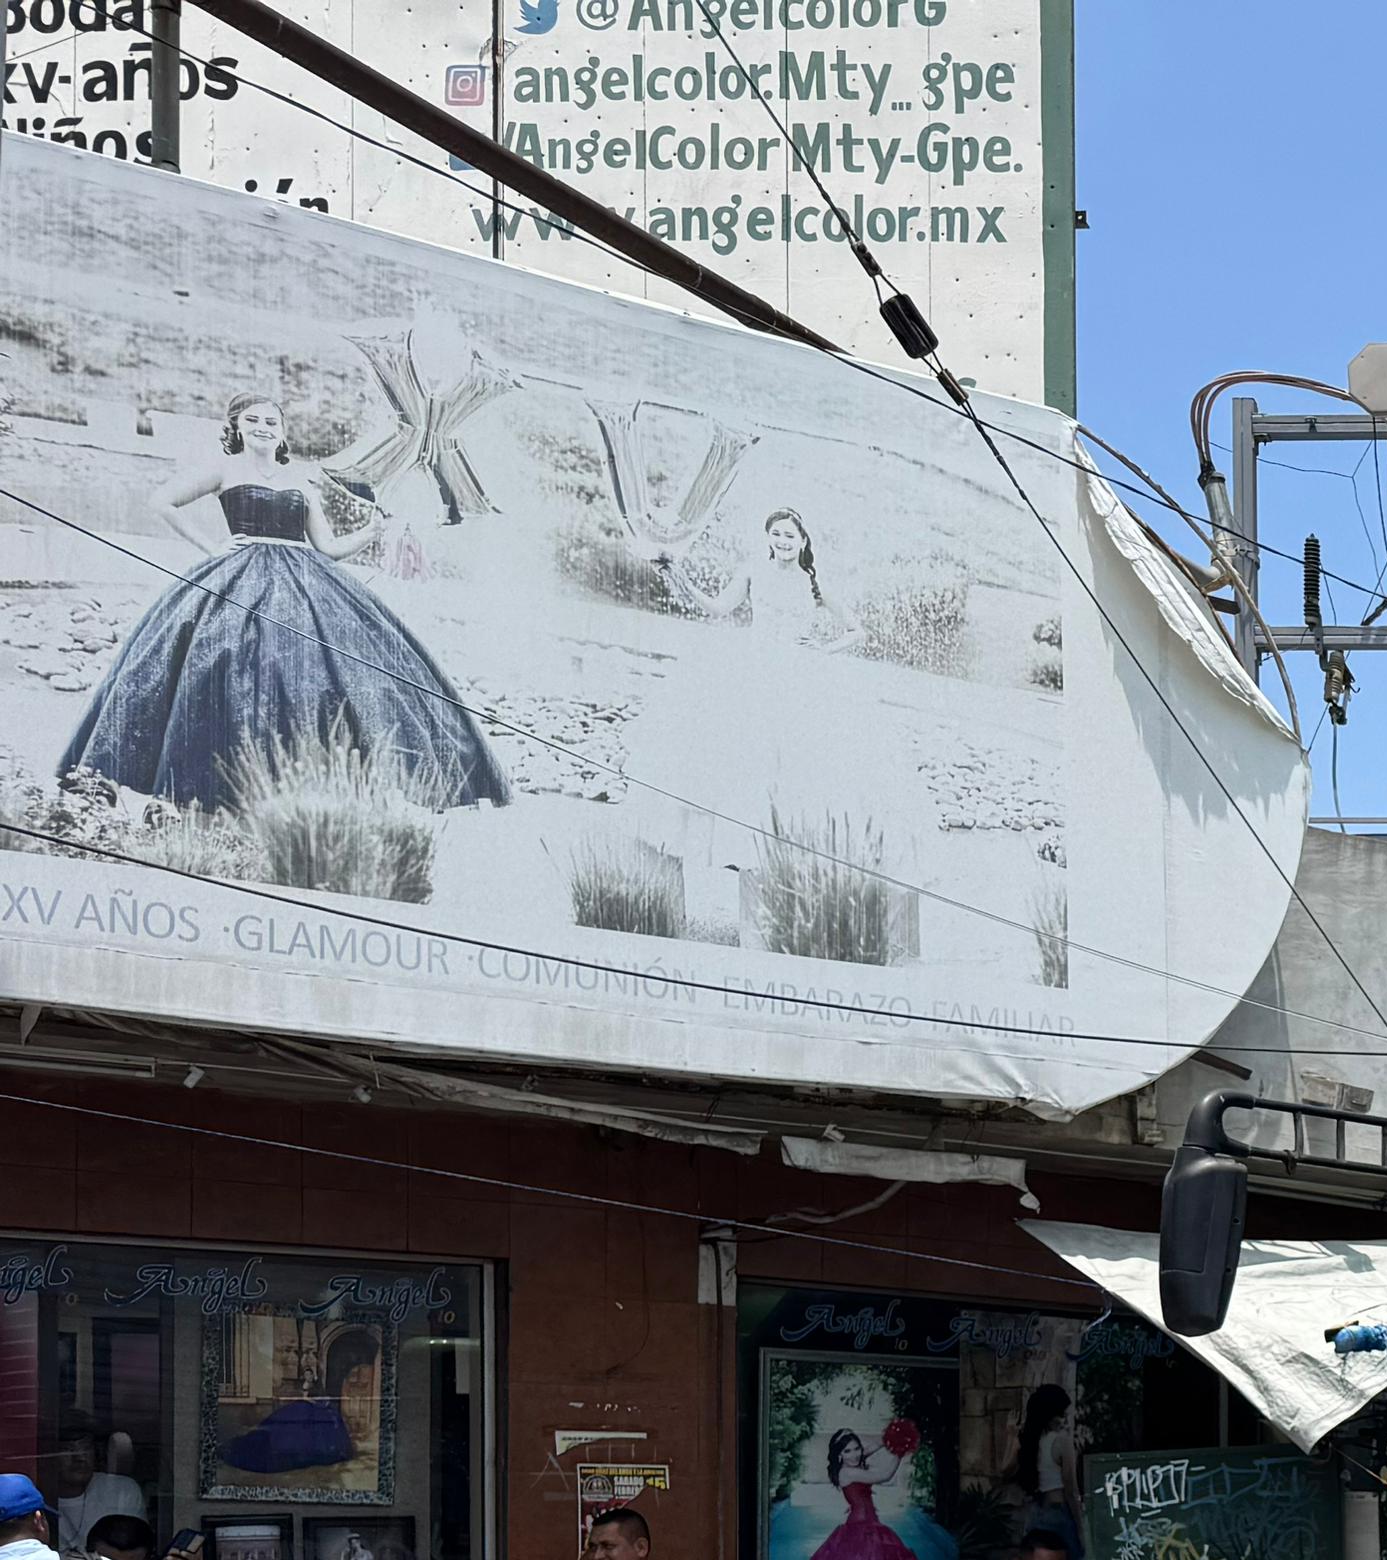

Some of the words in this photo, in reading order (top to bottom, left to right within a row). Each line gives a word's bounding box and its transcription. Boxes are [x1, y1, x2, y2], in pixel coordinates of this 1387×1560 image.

[2, 883, 62, 926] XV
[75, 888, 201, 944] AÑOS
[724, 975, 912, 1029] EMBARAZO
